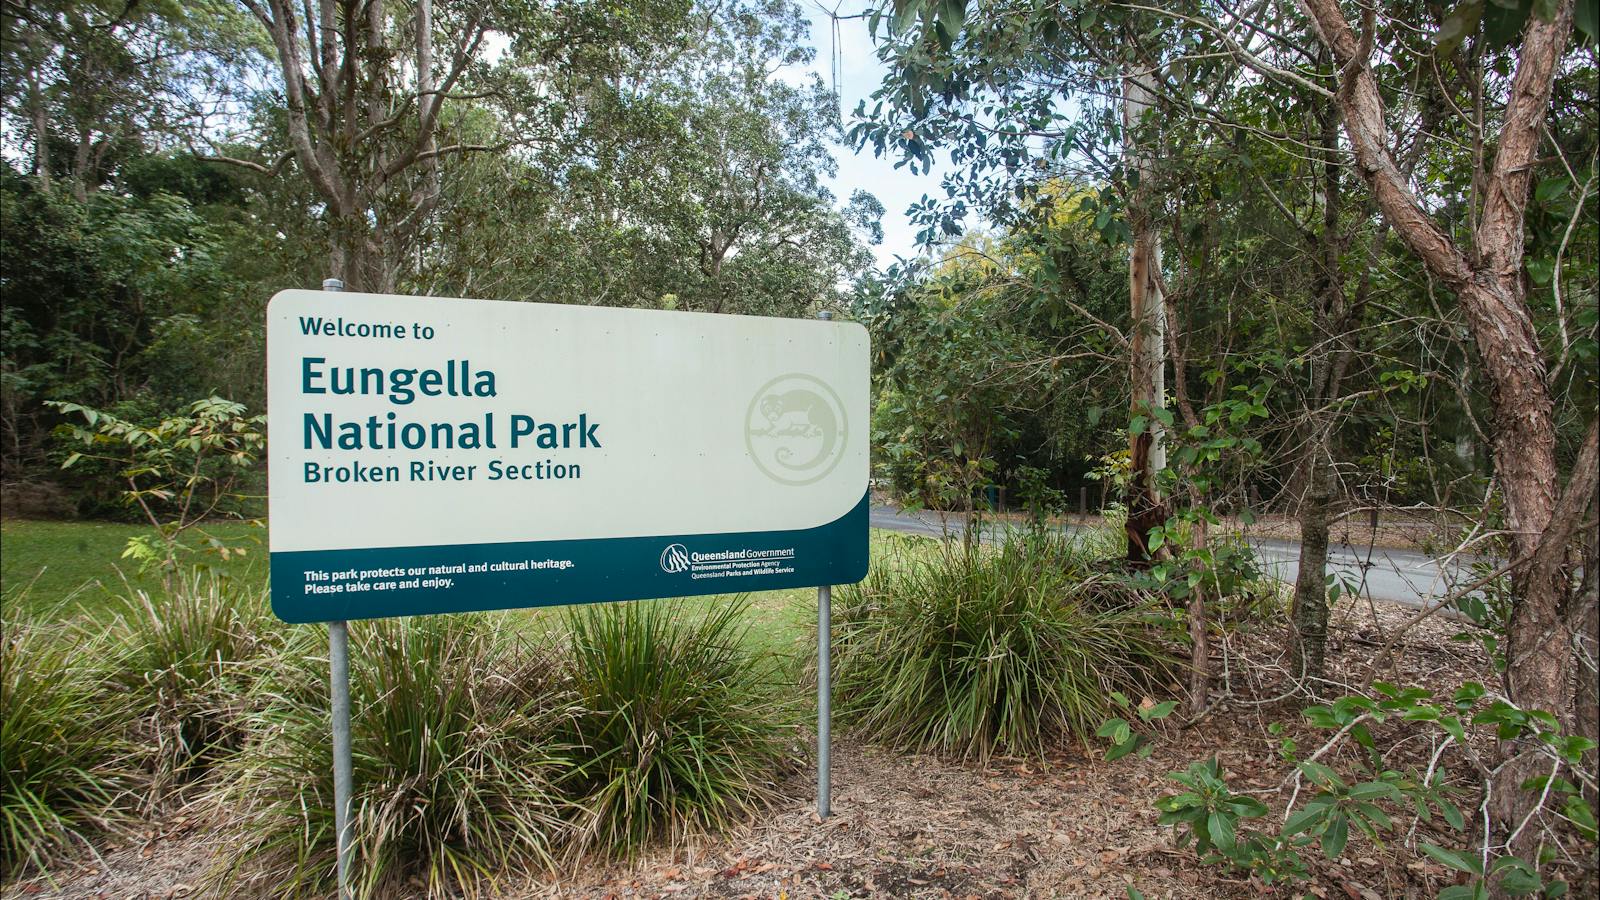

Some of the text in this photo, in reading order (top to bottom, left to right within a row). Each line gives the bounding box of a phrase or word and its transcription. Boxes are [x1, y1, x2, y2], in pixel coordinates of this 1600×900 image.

[299, 317, 435, 340] Welcome to
[303, 356, 498, 406] Eungella
[304, 411, 602, 451] National Park
[304, 459, 581, 483] Broken River Section
[691, 548, 795, 562] Queensland Government
[691, 562, 731, 571] Environmental
[732, 561, 760, 569] Protection
[304, 558, 575, 583] This park protects our natural and cultural heritage.
[691, 571, 726, 580] Queensland
[742, 568, 753, 576] and
[775, 566, 795, 574] Service
[304, 576, 455, 595] Please take care and enjoy.
